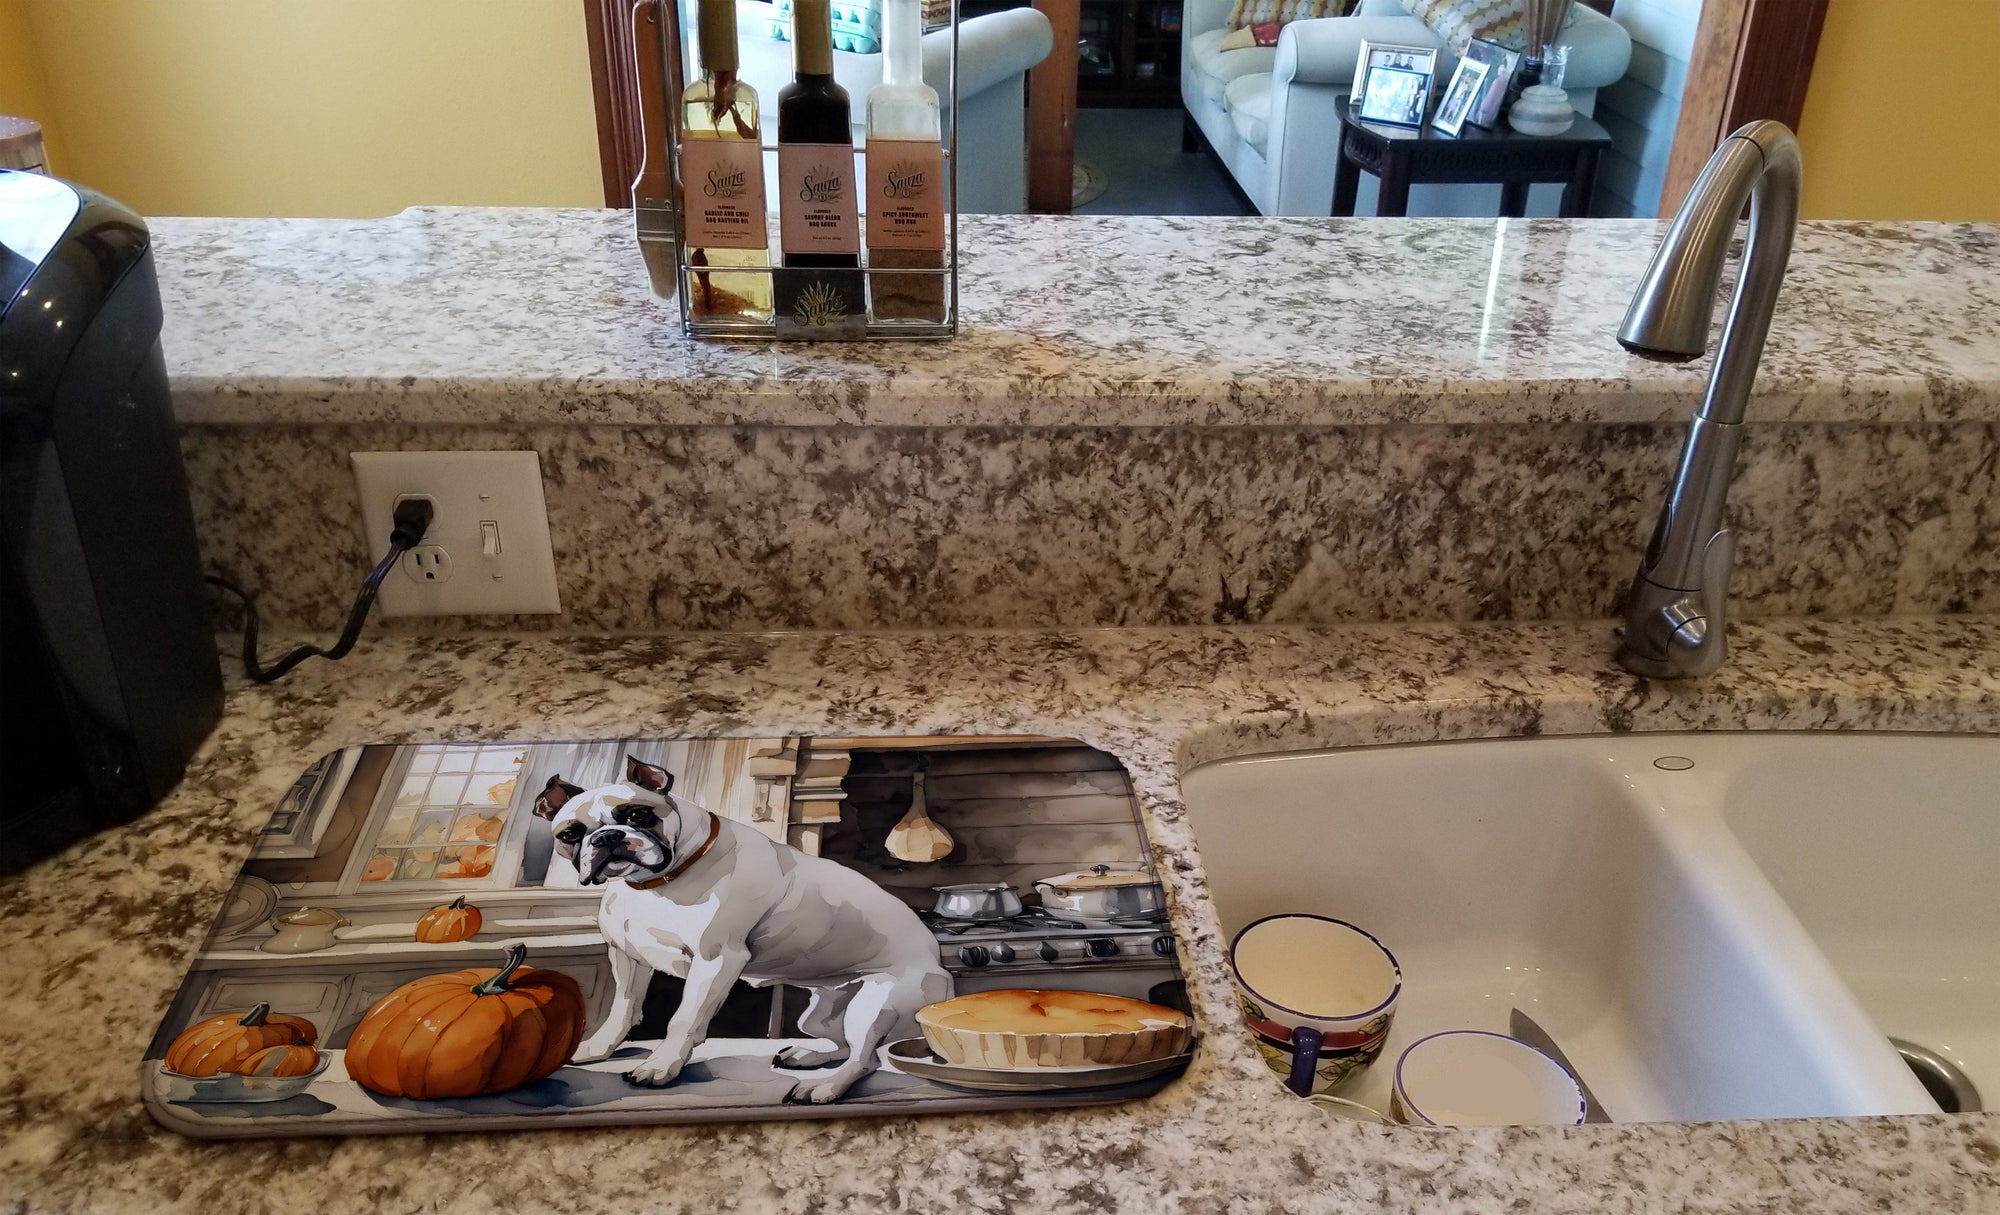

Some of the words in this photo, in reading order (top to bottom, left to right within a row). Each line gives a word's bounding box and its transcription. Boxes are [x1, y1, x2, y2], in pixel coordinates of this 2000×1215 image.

[703, 170, 746, 197] Sauza
[800, 175, 842, 202] Sauza
[884, 171, 926, 198] Sauza
